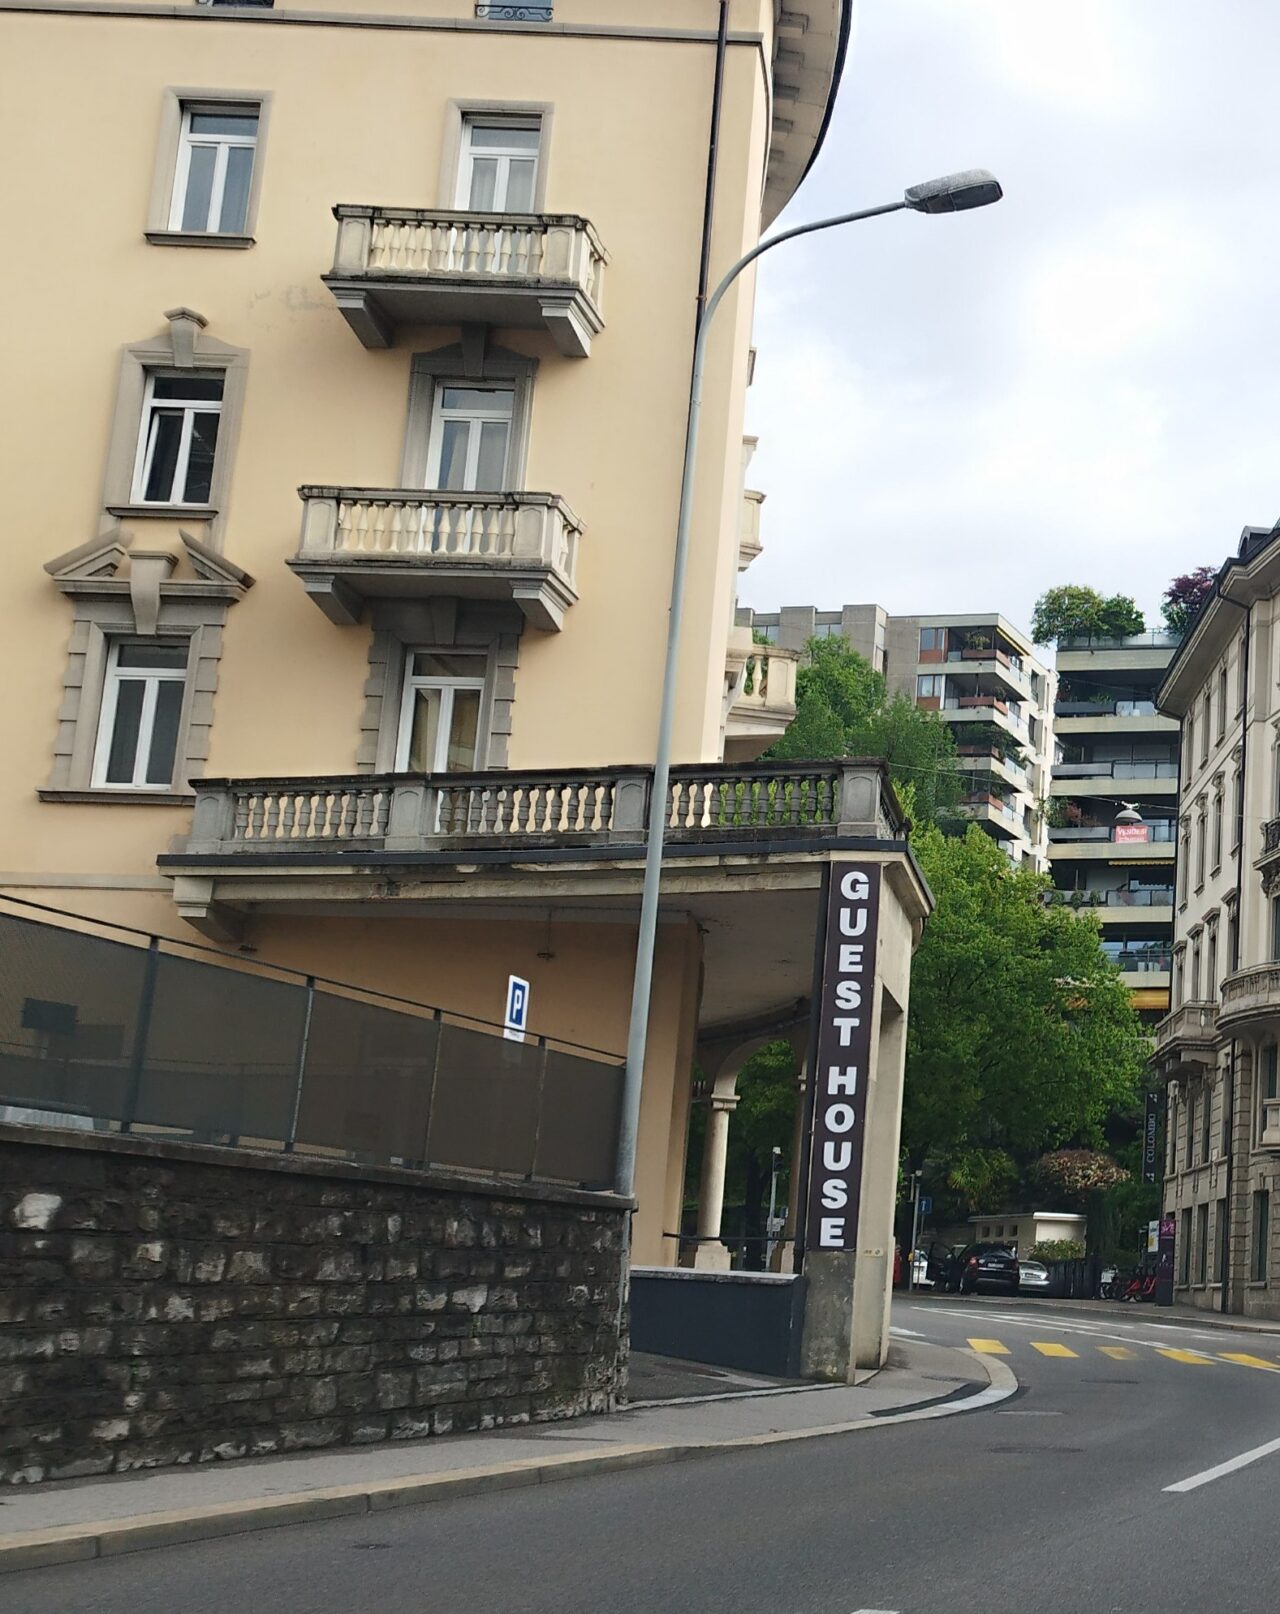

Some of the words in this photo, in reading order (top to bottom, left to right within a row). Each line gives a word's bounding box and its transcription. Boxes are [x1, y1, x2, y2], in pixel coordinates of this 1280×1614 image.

[512, 988, 523, 1020] P
[832, 871, 869, 1046] GUEST
[820, 1066, 857, 1247] HOUSE
[1147, 1113, 1156, 1163] COLOMBO
